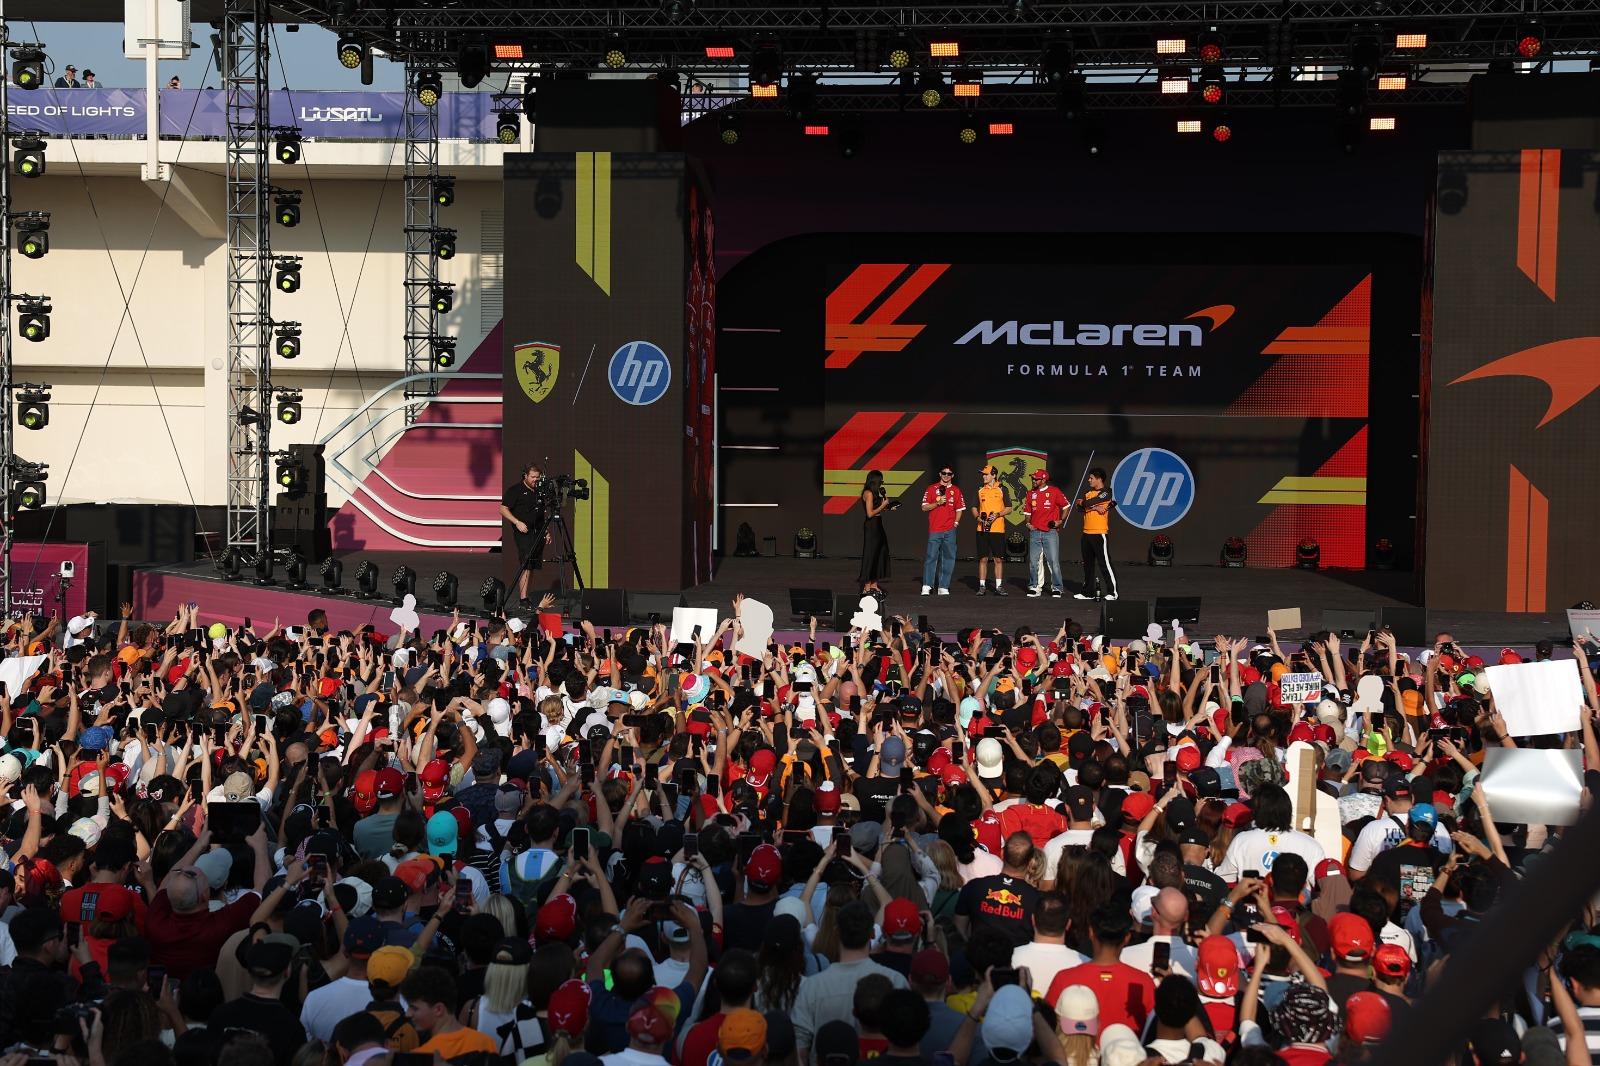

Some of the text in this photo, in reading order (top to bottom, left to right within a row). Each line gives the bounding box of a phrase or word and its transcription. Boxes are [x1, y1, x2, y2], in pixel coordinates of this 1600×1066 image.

[44, 105, 68, 117] OF
[71, 106, 135, 117] LIGHTS
[952, 320, 1203, 347] McLaren
[617, 341, 664, 405] hp
[1006, 364, 1109, 376] FORMULA
[1145, 365, 1202, 377] TEAM
[1121, 448, 1185, 530] hp
[1299, 673, 1321, 683] #VIDEO
[1282, 683, 1295, 693] PLS
[1295, 683, 1305, 692] ME
[1281, 692, 1304, 702] TEAMS
[980, 900, 1025, 920] Red Bull
